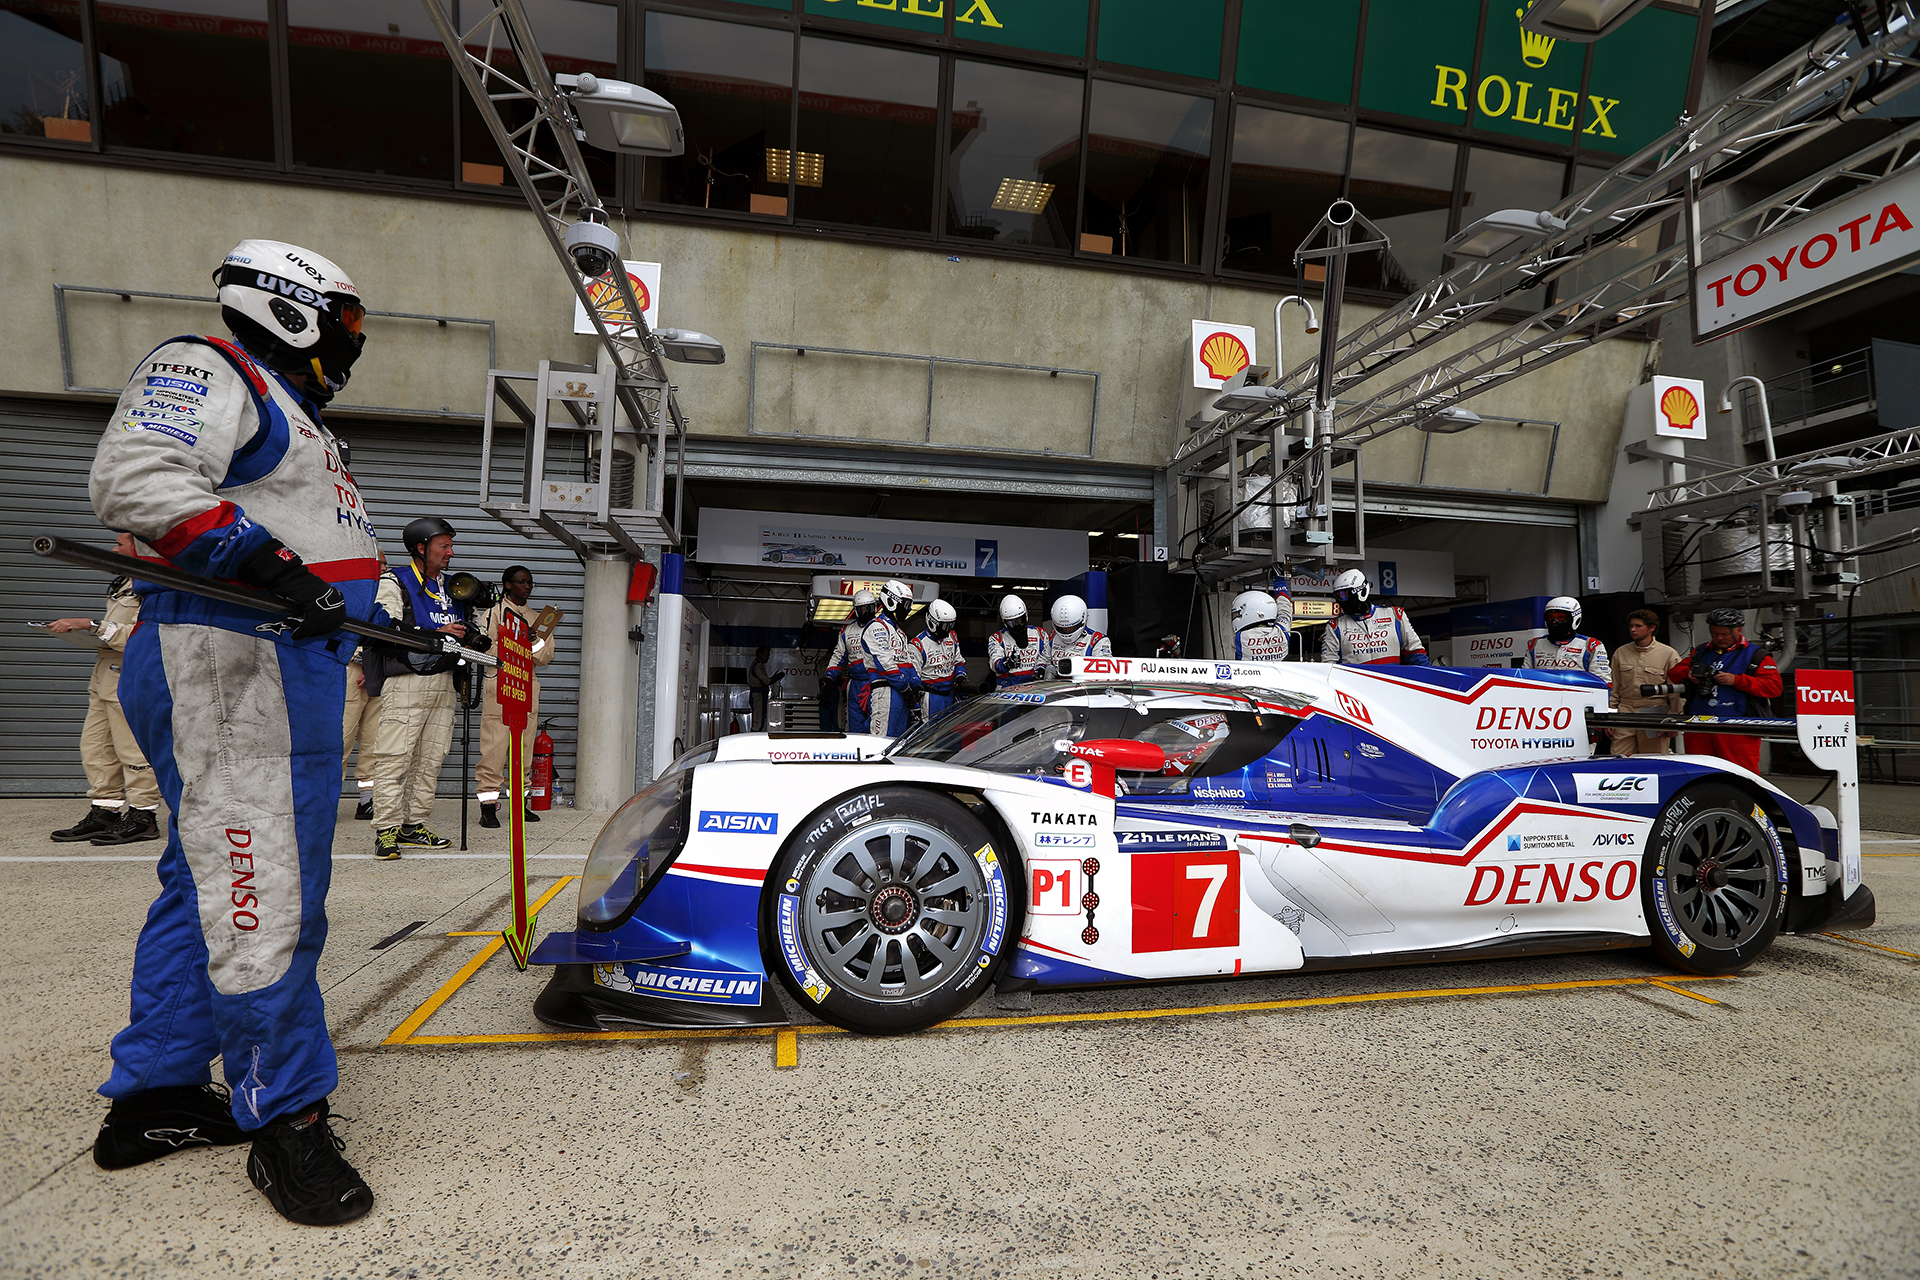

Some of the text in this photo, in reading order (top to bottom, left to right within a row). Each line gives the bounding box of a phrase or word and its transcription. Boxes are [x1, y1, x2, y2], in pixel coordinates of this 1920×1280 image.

[1430, 64, 1620, 139] ROLEX
[1707, 202, 1914, 308] TOYOTA
[285, 252, 328, 285] uvex
[256, 273, 333, 312] uvex
[150, 363, 214, 381] JTEKT
[151, 378, 204, 394] AISIN
[147, 423, 198, 443] MICHELIN
[891, 543, 942, 556] DENSO
[1158, 548, 1164, 560] 2
[865, 556, 967, 569] TOYOTA HYBRID
[980, 547, 994, 569] 7
[1382, 568, 1394, 589] 8
[1591, 578, 1596, 588] 1
[843, 581, 853, 595] 7
[1333, 602, 1340, 615] 8
[503, 636, 532, 660] IGNITION OFF
[1248, 635, 1284, 646] DENSO
[1352, 640, 1387, 649] TOYOTA
[1470, 637, 1513, 651] DENSO
[1251, 646, 1283, 654] TOYOTA
[1251, 653, 1283, 661] HYBRID
[1353, 647, 1388, 655] HYBRID
[503, 661, 529, 682] BRAKES ON
[1083, 658, 1132, 675] ZENT
[1158, 666, 1188, 674] AISIN
[1191, 667, 1208, 675] AW
[1233, 667, 1261, 676] zf.com
[1537, 659, 1577, 668] DENSO
[503, 684, 526, 701] PIT SPEED
[1797, 686, 1854, 702] TOTAL
[1476, 707, 1572, 730] DENSO
[1471, 738, 1575, 749] TOYOTA HYBRID
[1812, 736, 1847, 750] JTEKT
[768, 752, 810, 760] TOYOTA
[1072, 765, 1084, 782] E
[1598, 776, 1648, 791] WEC
[704, 814, 773, 832] AISIN
[1030, 812, 1098, 826] TAKATA
[1039, 835, 1093, 845] 林テレンプ
[1156, 834, 1175, 842] LE
[1177, 833, 1221, 842] MANS
[1768, 826, 1788, 880] MICHELIN
[225, 828, 259, 932] DENSO
[1805, 866, 1826, 878] TMG
[1032, 869, 1071, 907] P1
[1463, 860, 1637, 906] DENSO
[1186, 864, 1227, 938] 7
[1657, 881, 1679, 936] MICHELIN
[987, 878, 1005, 951] MICHELIN
[781, 898, 803, 973] MICHELIN
[635, 971, 758, 995] MICHELIN
